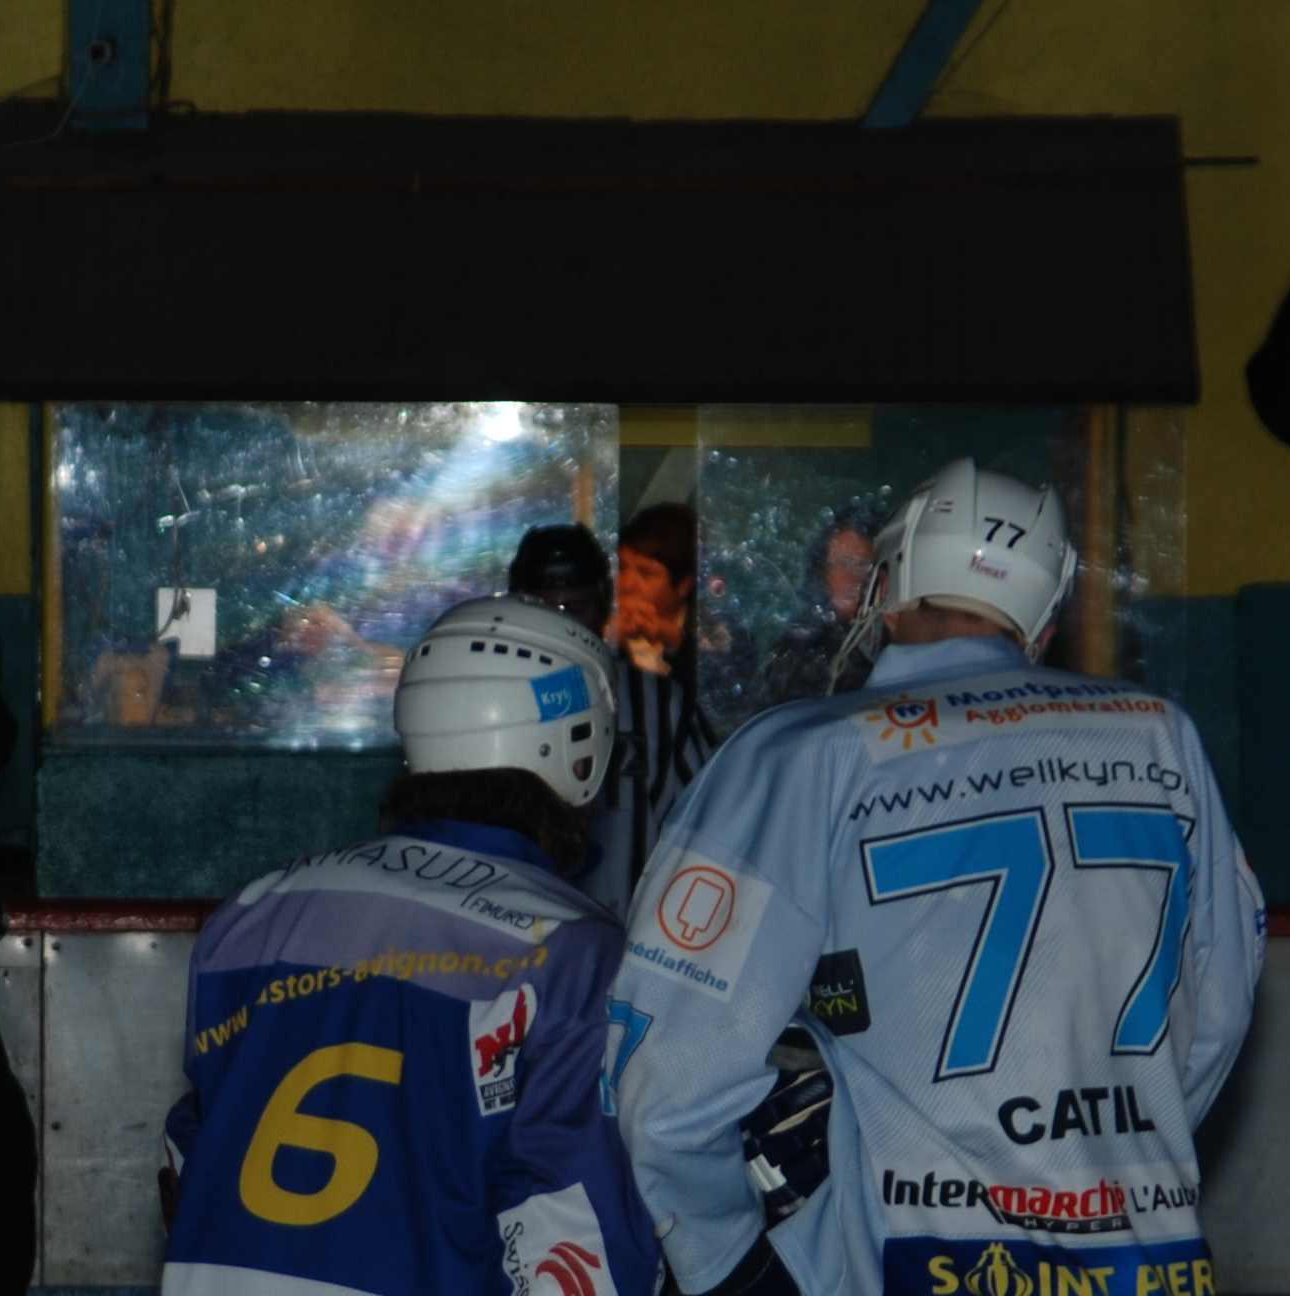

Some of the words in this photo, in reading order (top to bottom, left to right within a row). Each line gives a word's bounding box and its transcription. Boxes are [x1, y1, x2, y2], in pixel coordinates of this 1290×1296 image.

[984, 515, 1027, 549] 77
[628, 938, 730, 992] édiaffiche
[859, 802, 1196, 1084] 77
[238, 1040, 405, 1227] 6
[997, 1085, 1156, 1145] CATIL
